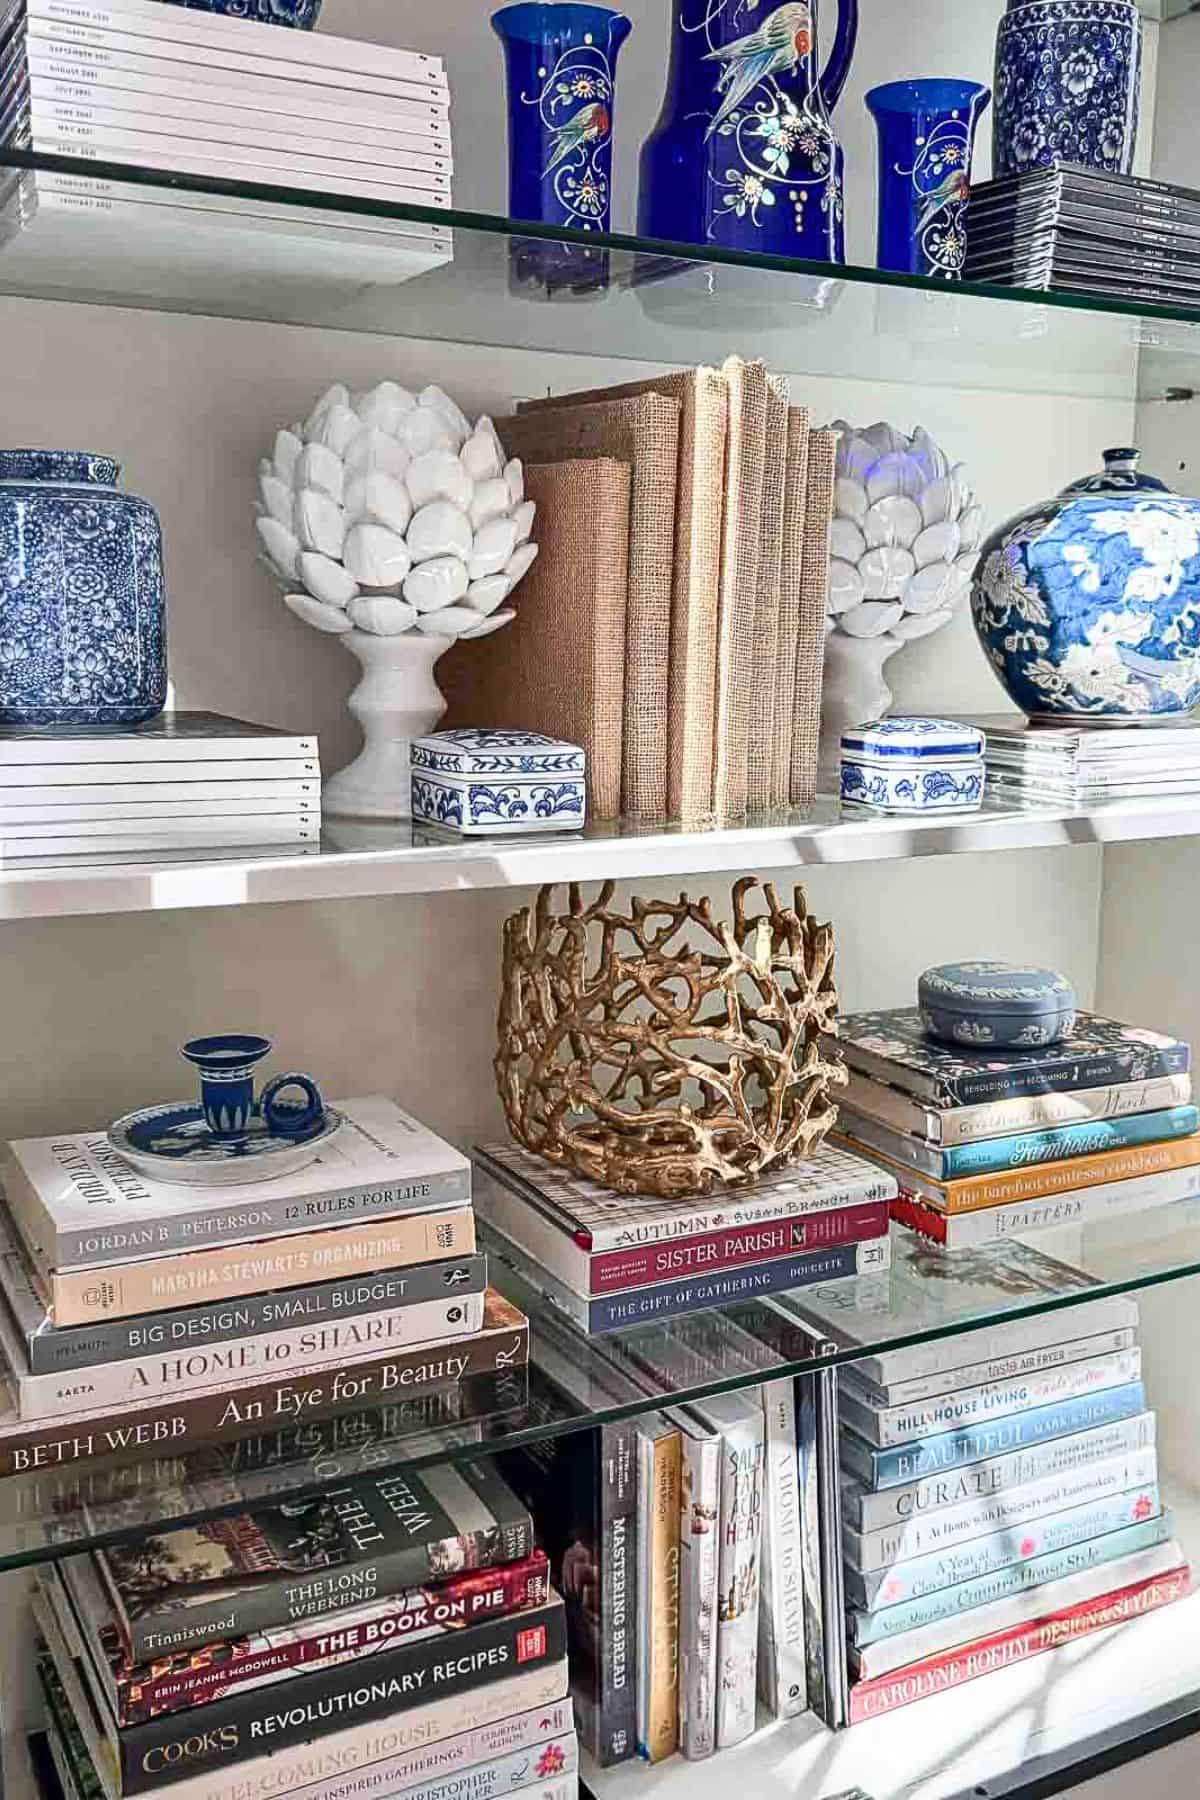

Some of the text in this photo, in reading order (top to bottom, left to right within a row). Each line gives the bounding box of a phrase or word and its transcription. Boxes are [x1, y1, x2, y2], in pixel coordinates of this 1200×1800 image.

[1008, 1132, 1109, 1165] Farmhouse
[78, 1228, 154, 1255] JORDAN
[181, 1210, 273, 1236] PETERSON
[285, 1206, 299, 1220] 12
[303, 1195, 356, 1216] RULES
[362, 1190, 393, 1206] FOR
[396, 1183, 432, 1200] LIFE
[615, 1193, 849, 1245] AUTUMN SUSAN BRANCH
[151, 1238, 402, 1297] MARTHA STEWART'S ORGANIZING
[655, 1227, 784, 1272] SISTER PARISH
[128, 1279, 409, 1347] BIG DESIGN, SMALL BUDGET
[607, 1272, 772, 1321] THE GIFT OF GATHERING
[128, 1315, 403, 1390] A HOME to SHARE
[12, 1353, 470, 1471] BETH WEBB An Eye for Beauty
[896, 1386, 1028, 1432] HILL HOUSE LIVING
[897, 1424, 1027, 1479] BEAUTIFUL
[895, 1465, 1003, 1517] CURATE
[285, 1567, 378, 1604] THE LONG
[287, 1586, 378, 1620] WEEKEND
[612, 1517, 627, 1690] MASTERING BREAD
[143, 1612, 236, 1649] Tinniswood
[154, 1683, 182, 1699] ERIN
[184, 1670, 226, 1691] JEANNE
[228, 1652, 290, 1677] McDOWELL
[316, 1632, 359, 1655] THE
[366, 1612, 429, 1639] BOOK
[433, 1598, 466, 1620] ON
[471, 1589, 505, 1611] PIE
[662, 1546, 680, 1690] STYLED
[863, 1659, 962, 1712] CAROLYNE
[966, 1636, 1031, 1677] ROEHM
[142, 1724, 240, 1774] COOK'S
[250, 1670, 427, 1738] REVOLUTIONARY
[432, 1645, 509, 1683] RECIPES
[364, 1718, 442, 1758] HOUSE
[324, 1746, 465, 1800] INSPIRED GATHERINGS
[403, 1769, 498, 1800] HRISTOPHER
